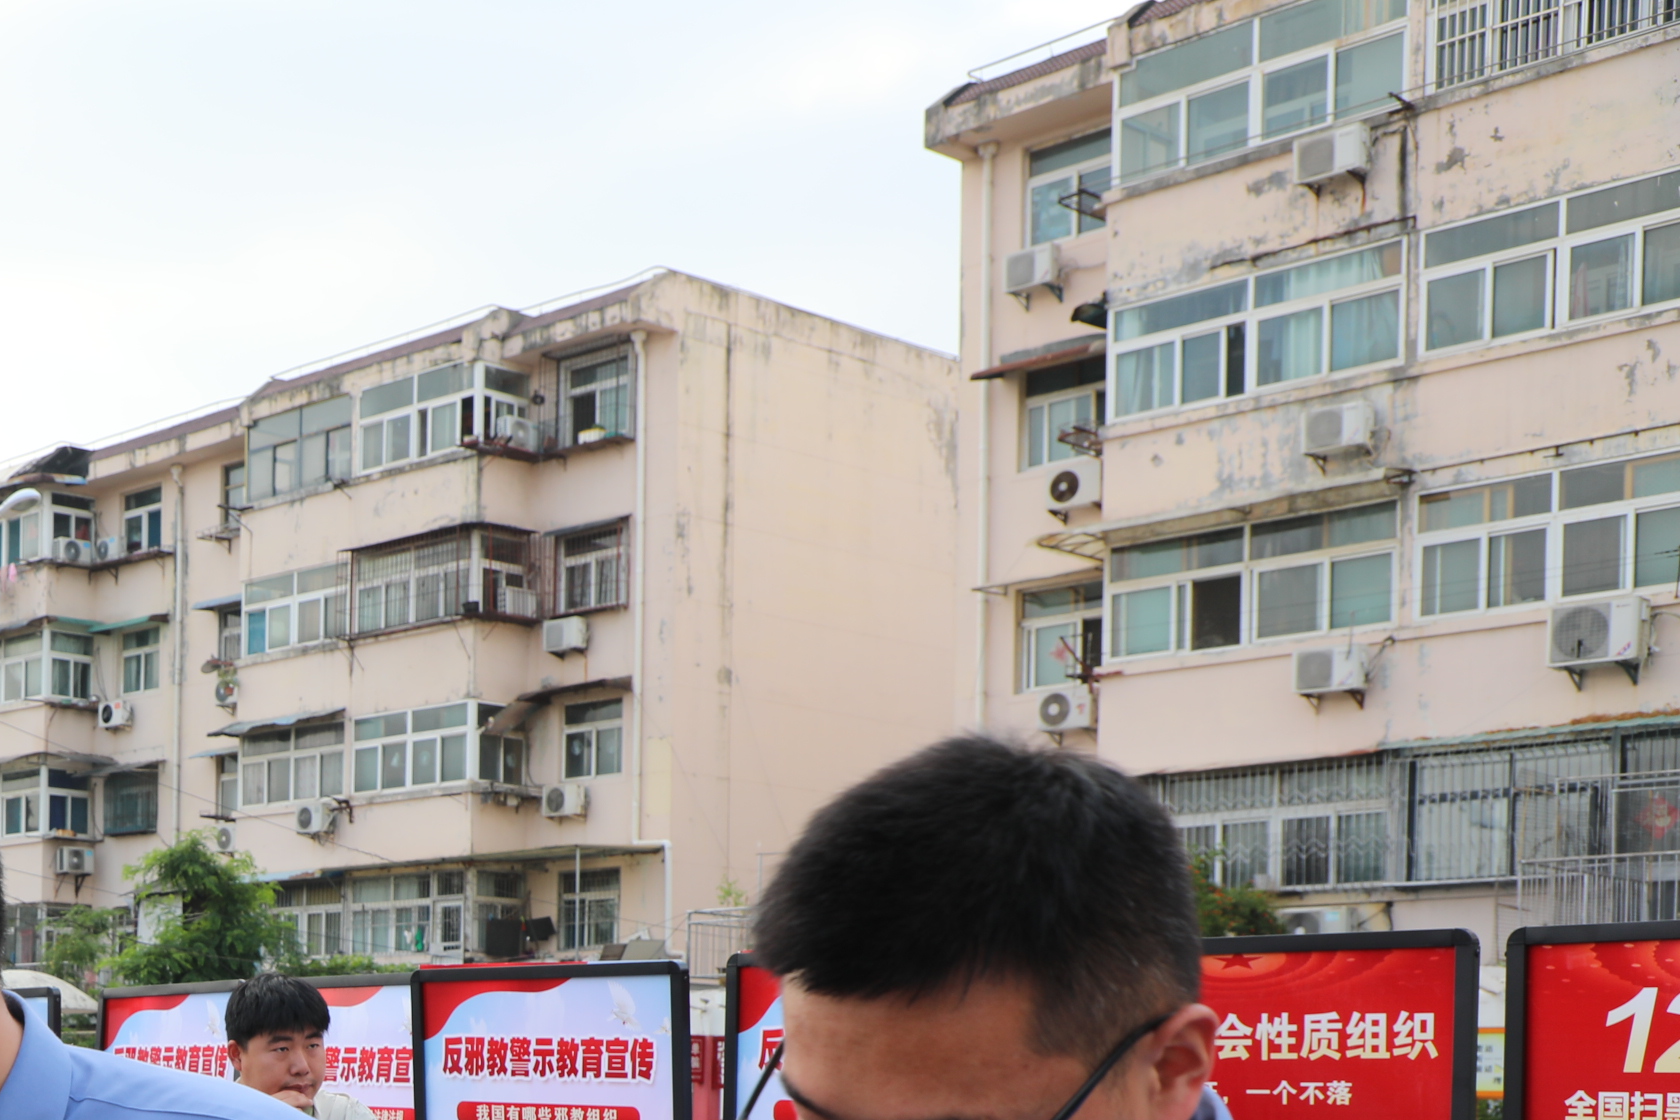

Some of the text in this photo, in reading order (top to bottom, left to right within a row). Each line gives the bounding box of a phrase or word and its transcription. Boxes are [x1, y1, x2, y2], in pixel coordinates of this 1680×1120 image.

[442, 1037, 654, 1080] 反邪教警示教育宣传
[1214, 1011, 1439, 1061] 会性质组织
